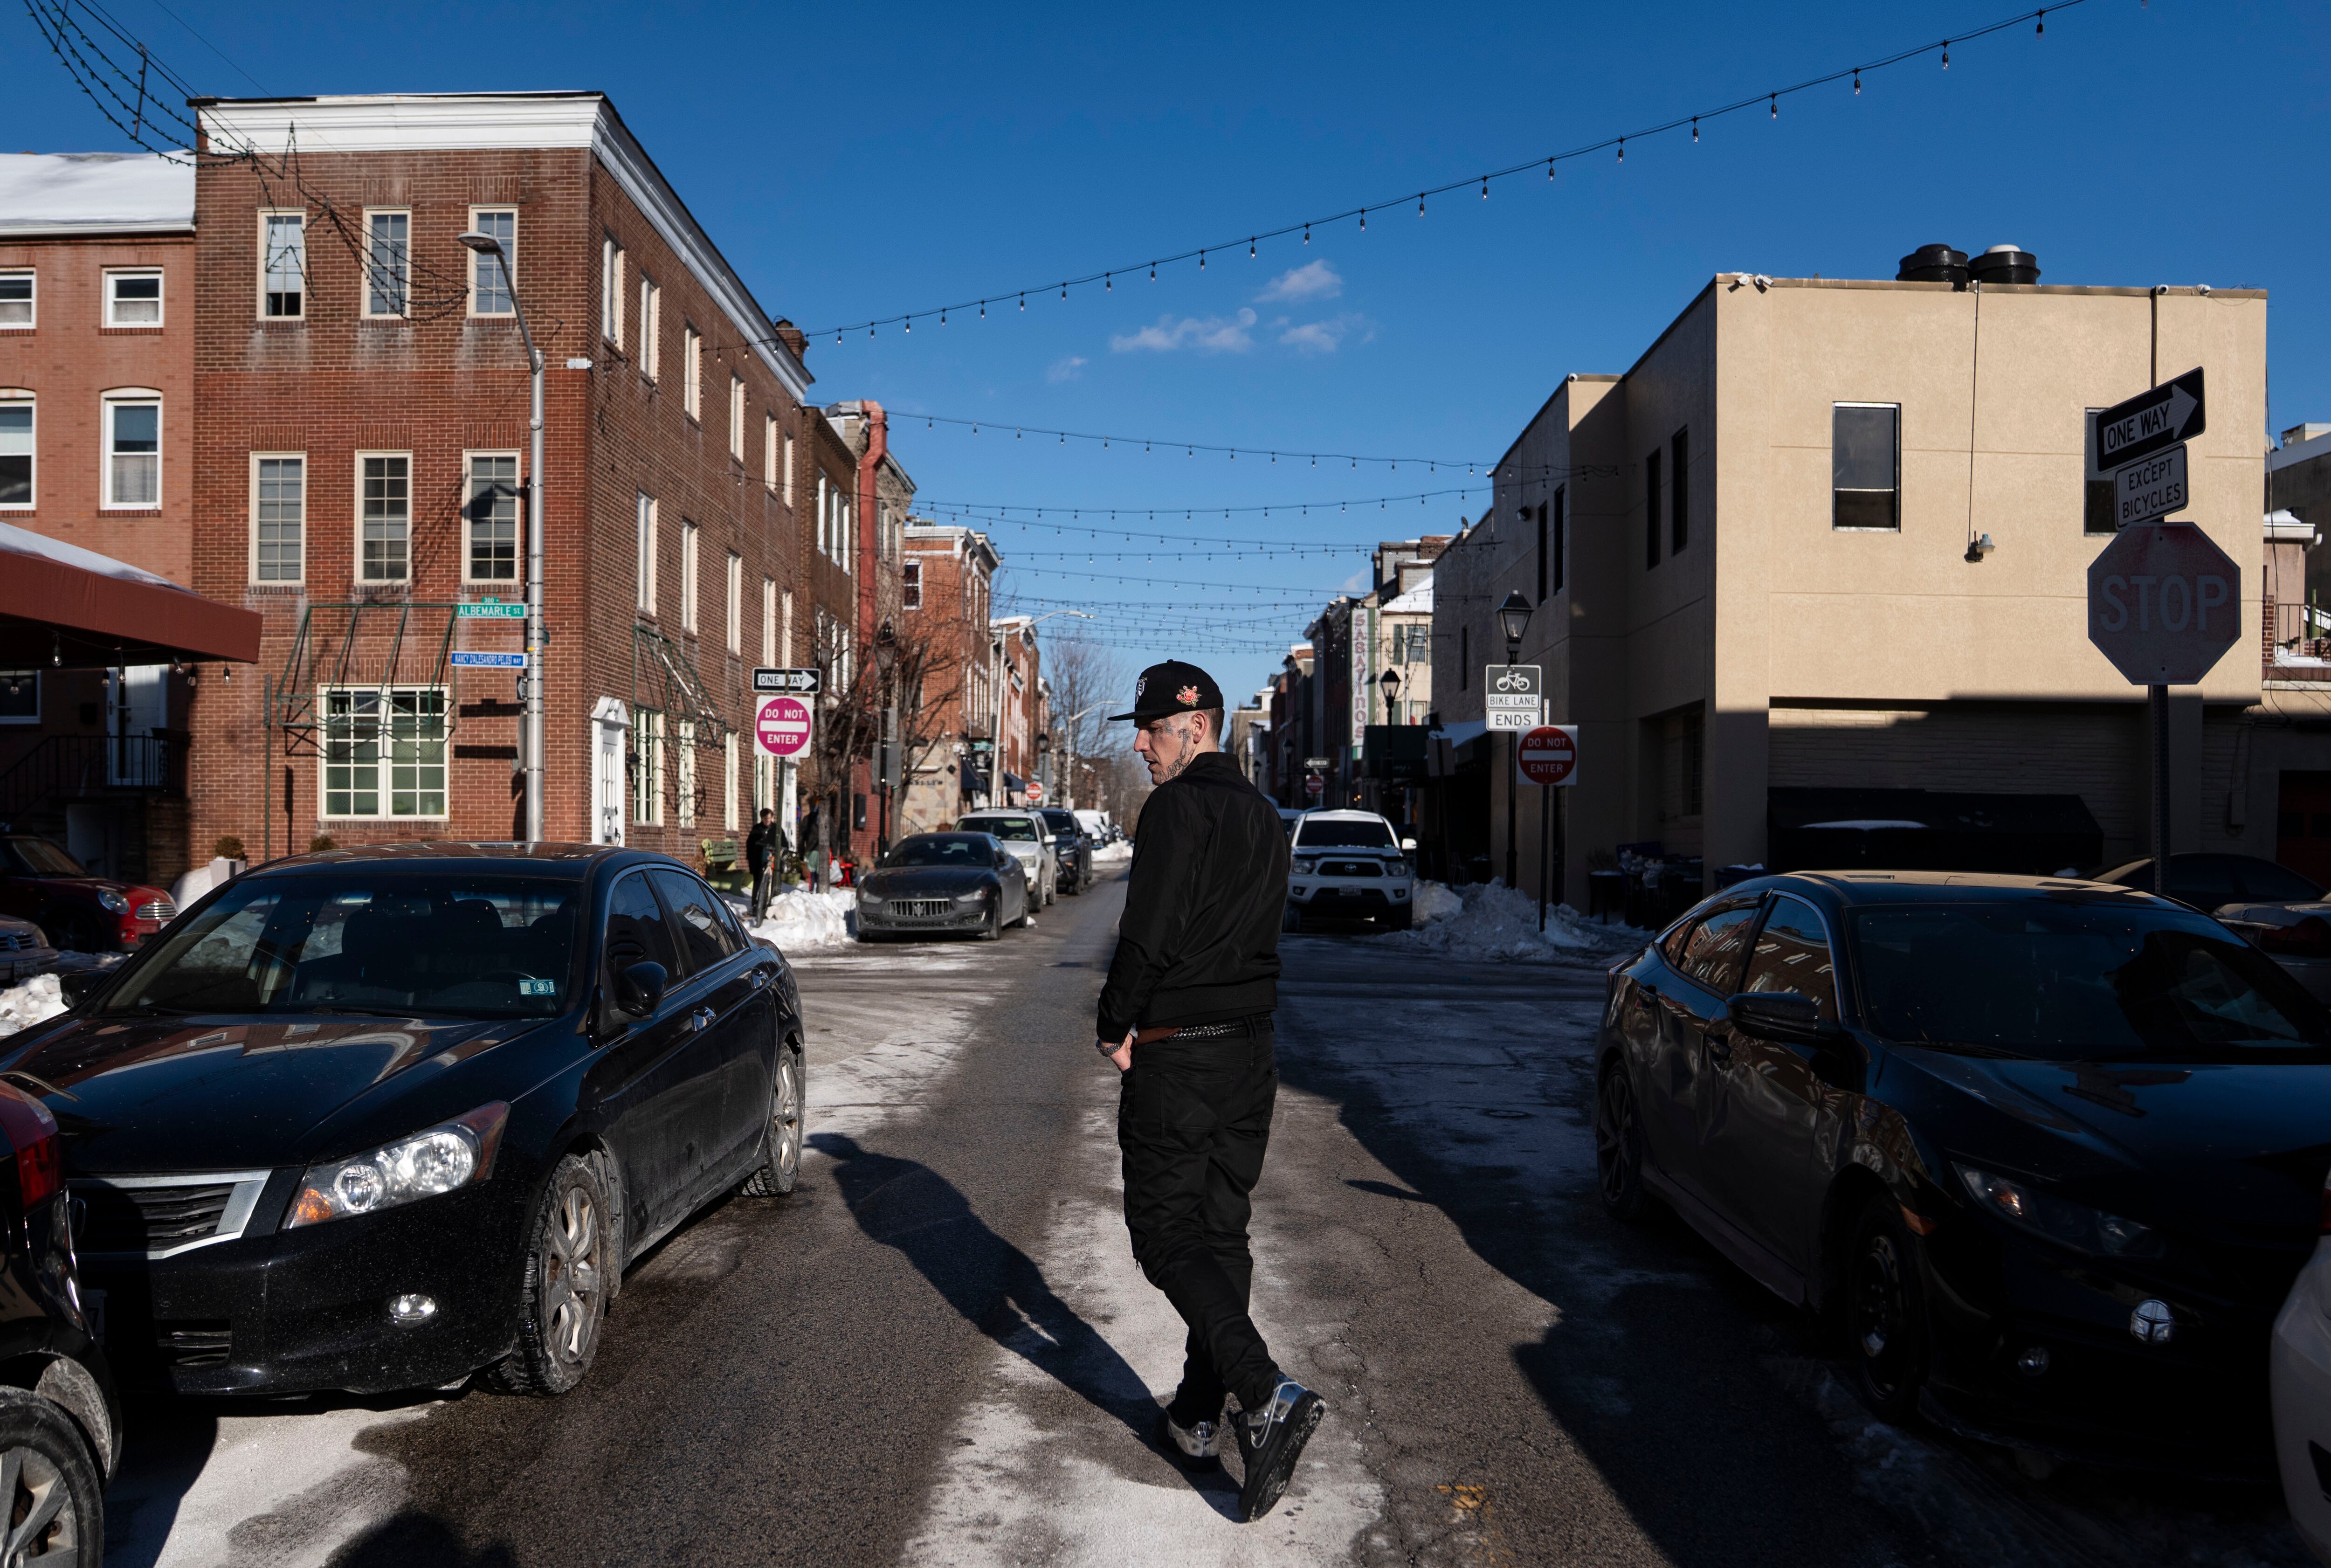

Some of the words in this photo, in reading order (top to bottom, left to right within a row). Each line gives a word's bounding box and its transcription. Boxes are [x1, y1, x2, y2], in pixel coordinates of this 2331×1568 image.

[2107, 418, 2136, 449] ONE
[2140, 403, 2170, 436] WAY
[2129, 458, 2172, 490] EXCEPT
[2123, 483, 2180, 519] BICYCLES
[2099, 574, 2228, 632] STOP
[459, 606, 511, 616] ALBEMARLE
[455, 654, 469, 664] NANCY
[470, 655, 497, 664] D'ALESANDRO
[498, 655, 512, 665] PELOSI
[760, 675, 779, 684] ONE
[1490, 696, 1510, 705] BIKE
[1514, 697, 1536, 705] LANE
[765, 708, 779, 718] DO
[784, 709, 804, 719] NOT
[1496, 714, 1531, 725] ENDS
[767, 734, 798, 745] ENTER
[1527, 738, 1541, 747] DO
[1547, 738, 1566, 747] NOT
[1530, 763, 1563, 773] ENTER
